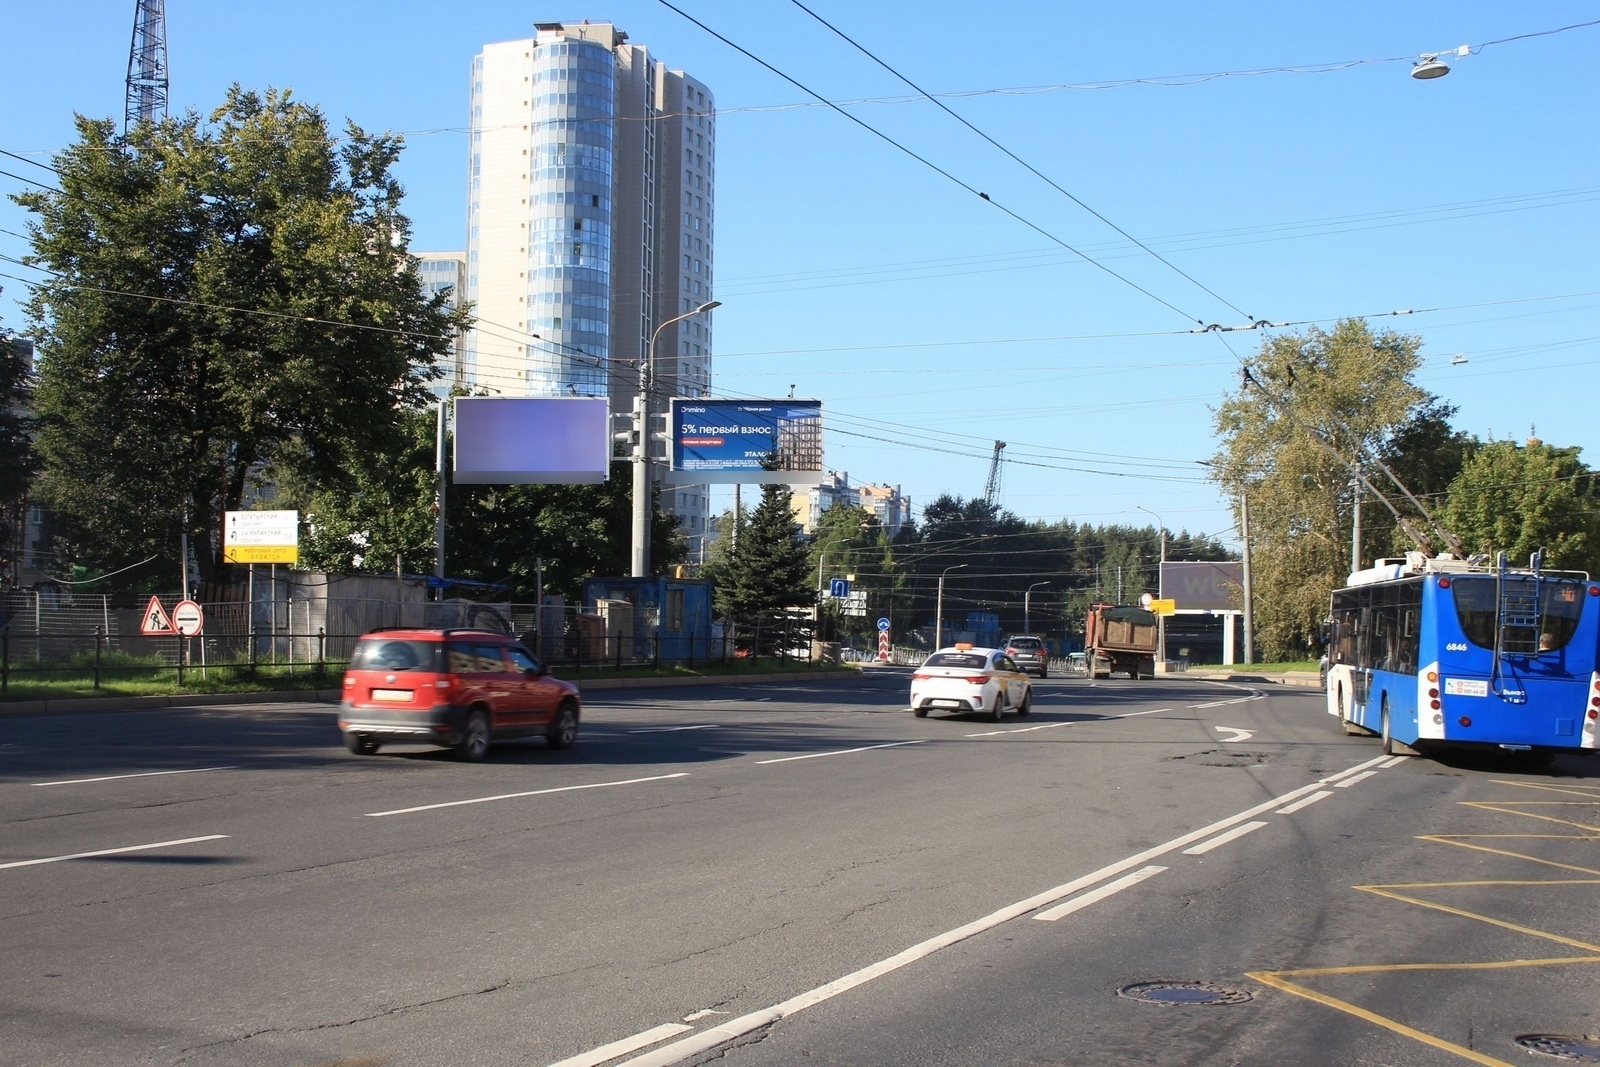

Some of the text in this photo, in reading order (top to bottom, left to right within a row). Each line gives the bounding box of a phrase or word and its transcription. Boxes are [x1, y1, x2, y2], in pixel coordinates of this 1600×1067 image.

[681, 424, 771, 436] 5% первый взнос
[1446, 643, 1467, 651] 6846
